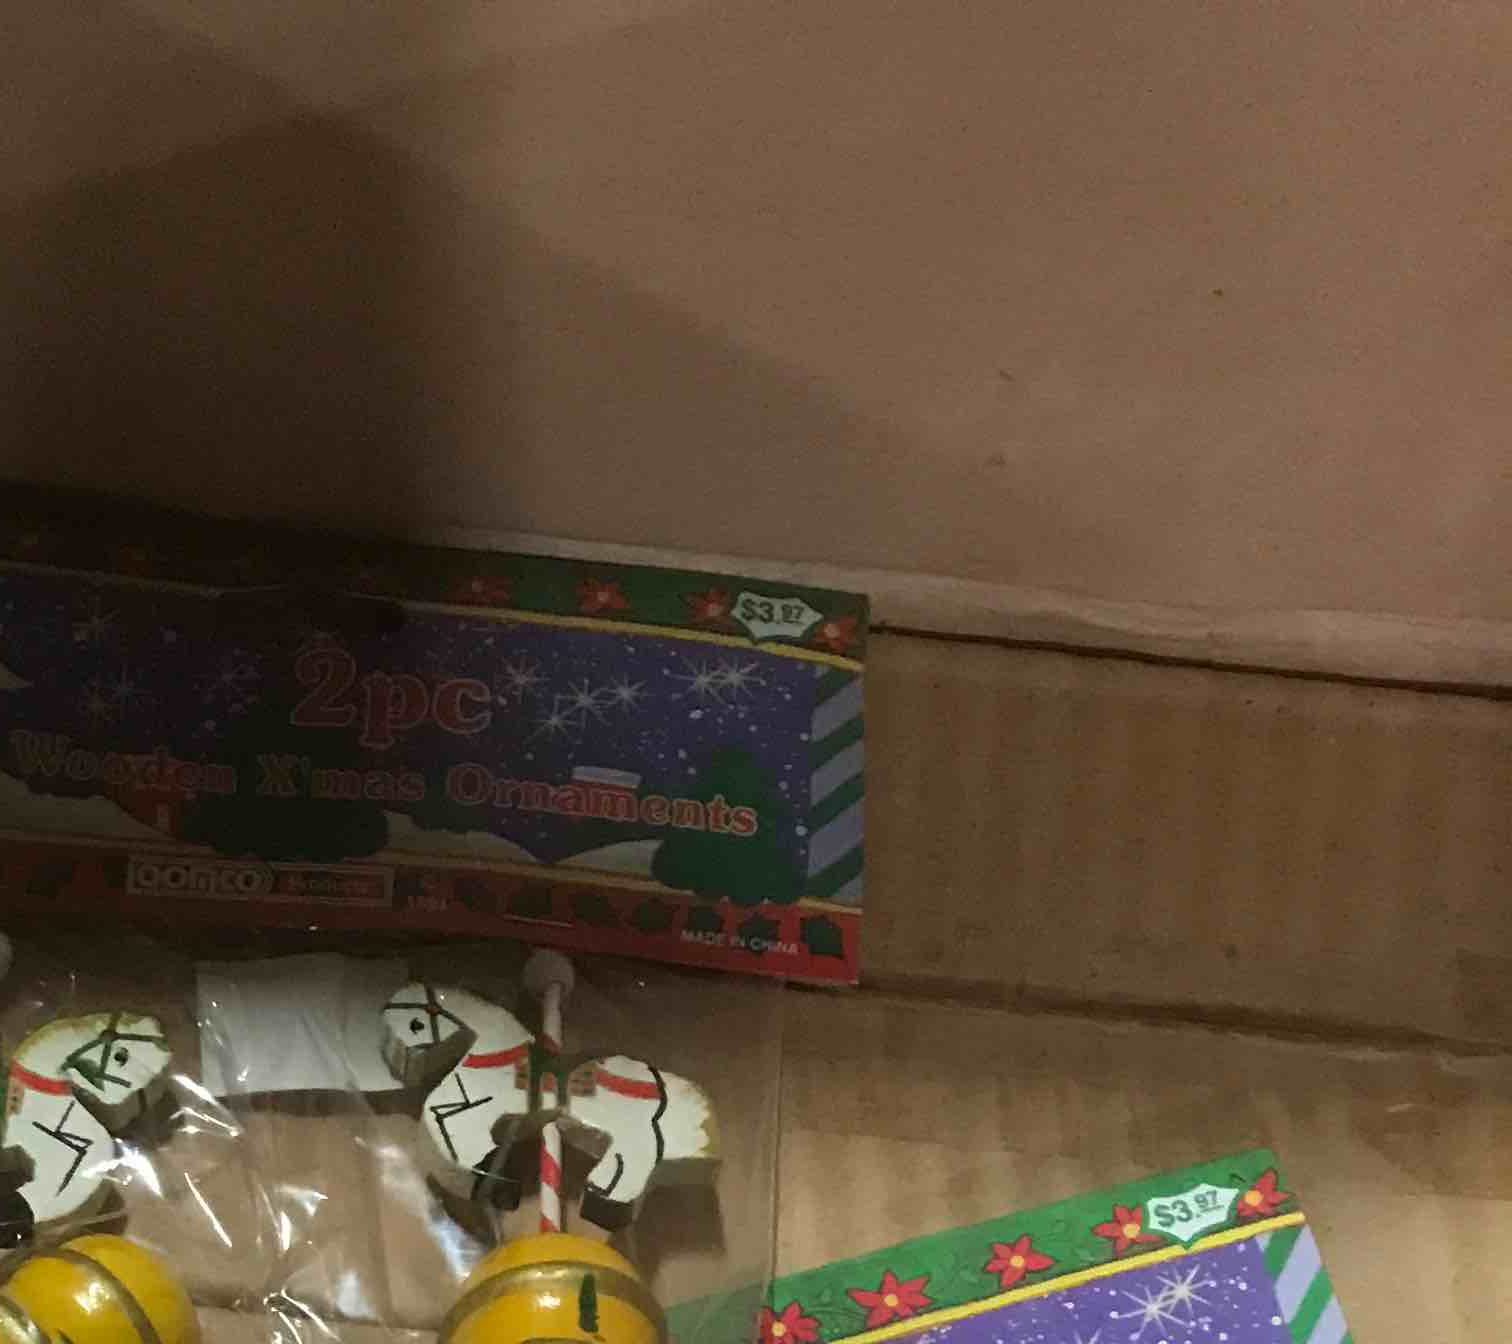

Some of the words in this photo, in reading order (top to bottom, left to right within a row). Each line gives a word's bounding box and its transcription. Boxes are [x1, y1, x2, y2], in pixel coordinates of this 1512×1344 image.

[290, 648, 493, 751] 2pc
[445, 761, 759, 837] Ornaments
[1154, 1189, 1219, 1228] $3.97
